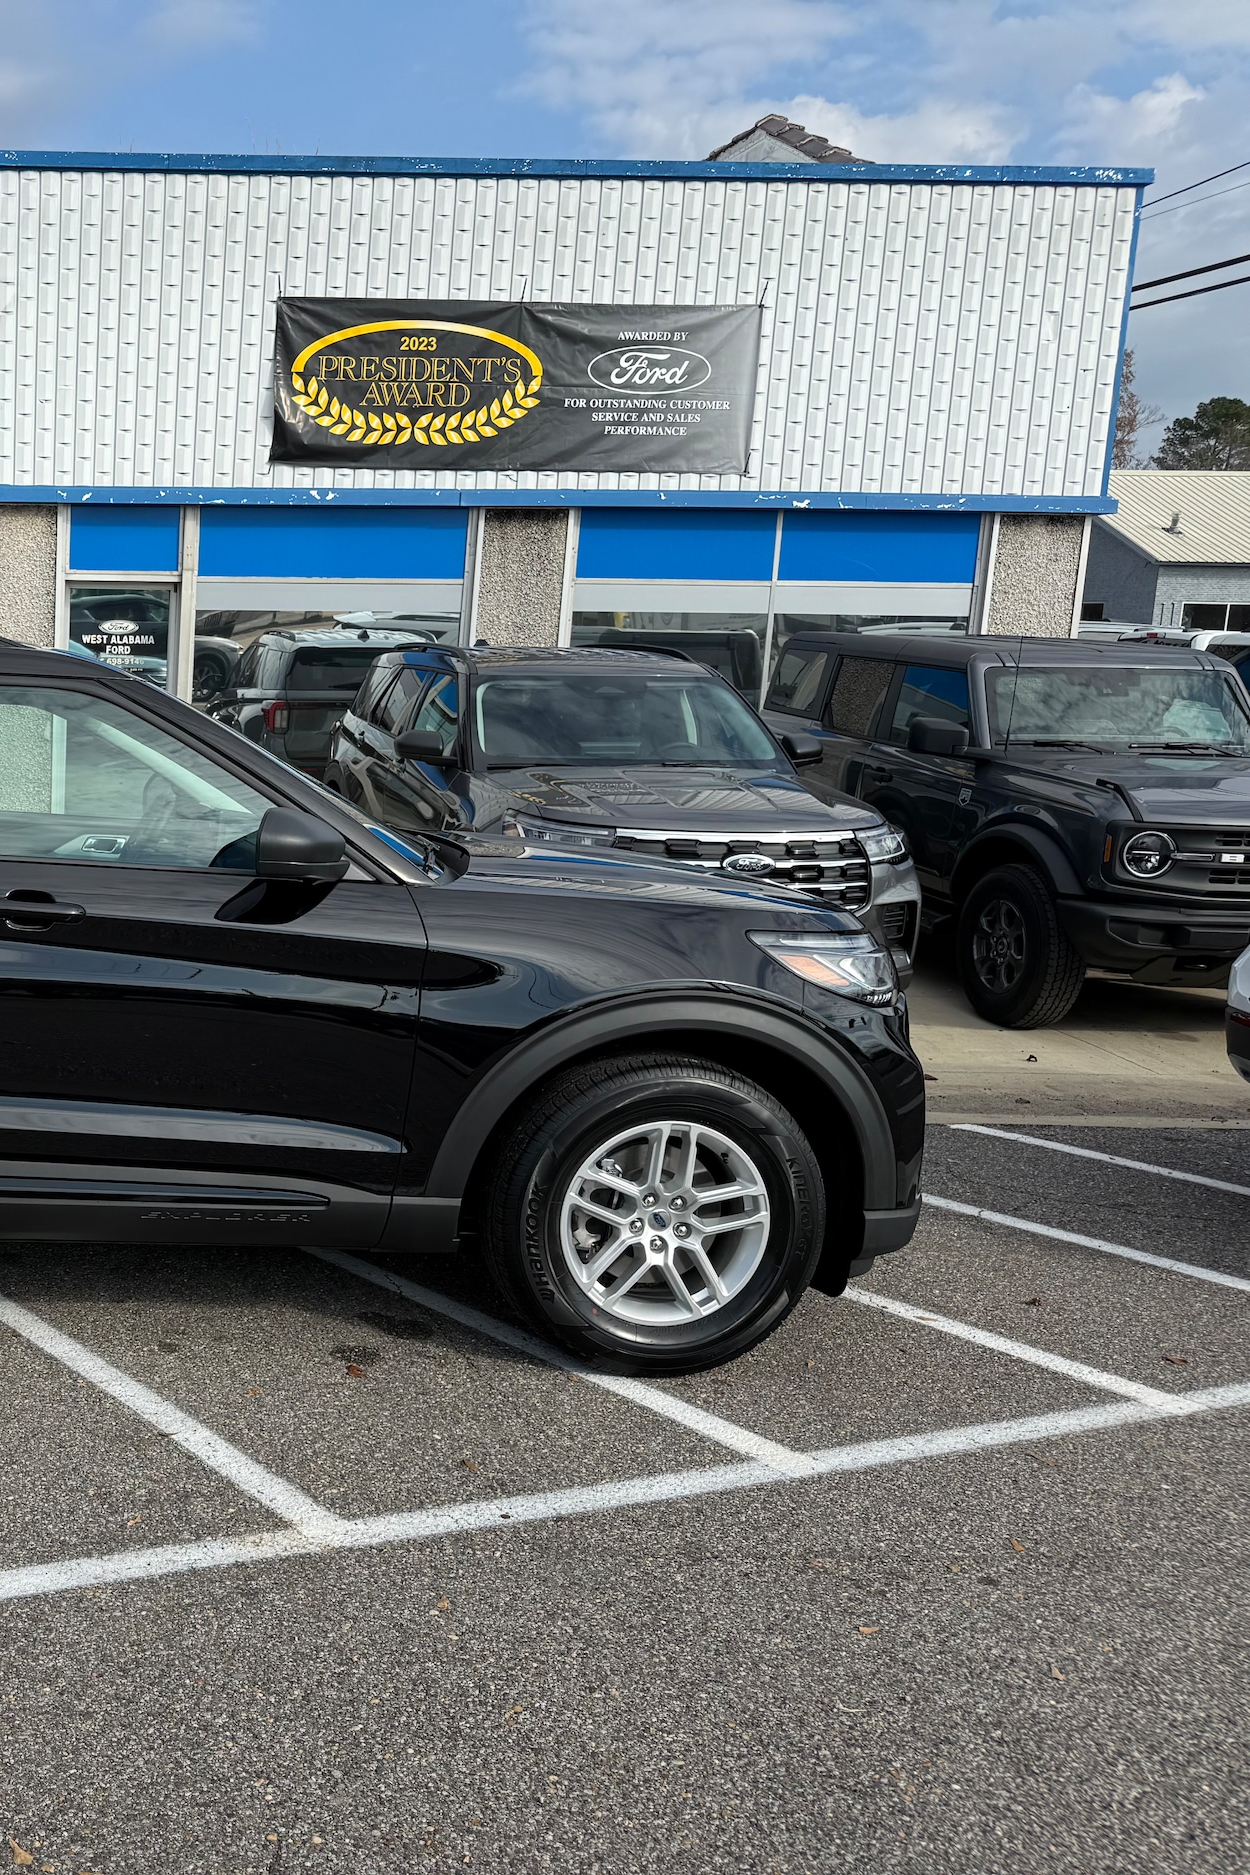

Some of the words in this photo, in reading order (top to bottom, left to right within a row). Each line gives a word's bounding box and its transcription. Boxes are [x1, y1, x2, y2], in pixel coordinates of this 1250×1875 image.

[617, 331, 671, 341] AWARDED
[673, 331, 689, 341] BY
[400, 336, 437, 351] 2023
[317, 355, 521, 383] PRESIDENT'S
[610, 351, 690, 385] Ford
[359, 382, 471, 407] AWARD
[564, 398, 587, 408] FOR
[589, 398, 667, 409] OUTSTANDING
[669, 399, 731, 410] CUSTOMER
[591, 412, 639, 422] SERVICE
[640, 412, 665, 422] AND
[666, 413, 701, 423] SALES
[604, 425, 688, 436] PERFORMANCE
[107, 622, 129, 631] Ford
[82, 635, 108, 644] WEST
[111, 635, 155, 644] ALABAMA
[106, 645, 131, 654] FORD
